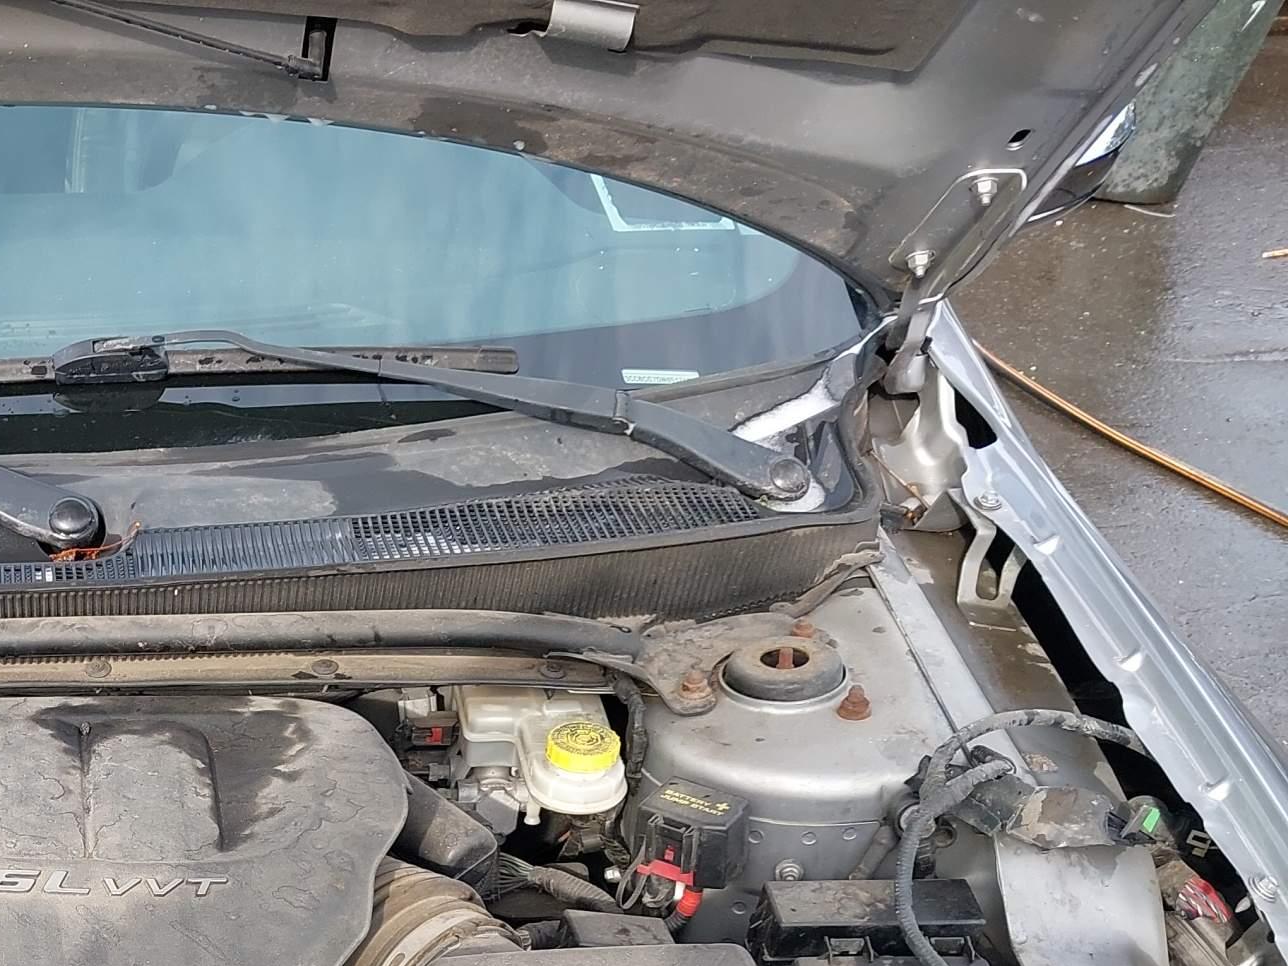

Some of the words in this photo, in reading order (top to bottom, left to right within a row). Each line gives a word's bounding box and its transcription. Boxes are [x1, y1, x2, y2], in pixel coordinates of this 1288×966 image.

[665, 789, 711, 806] BATTERY
[691, 803, 724, 815] START
[103, 877, 229, 897] VVT
